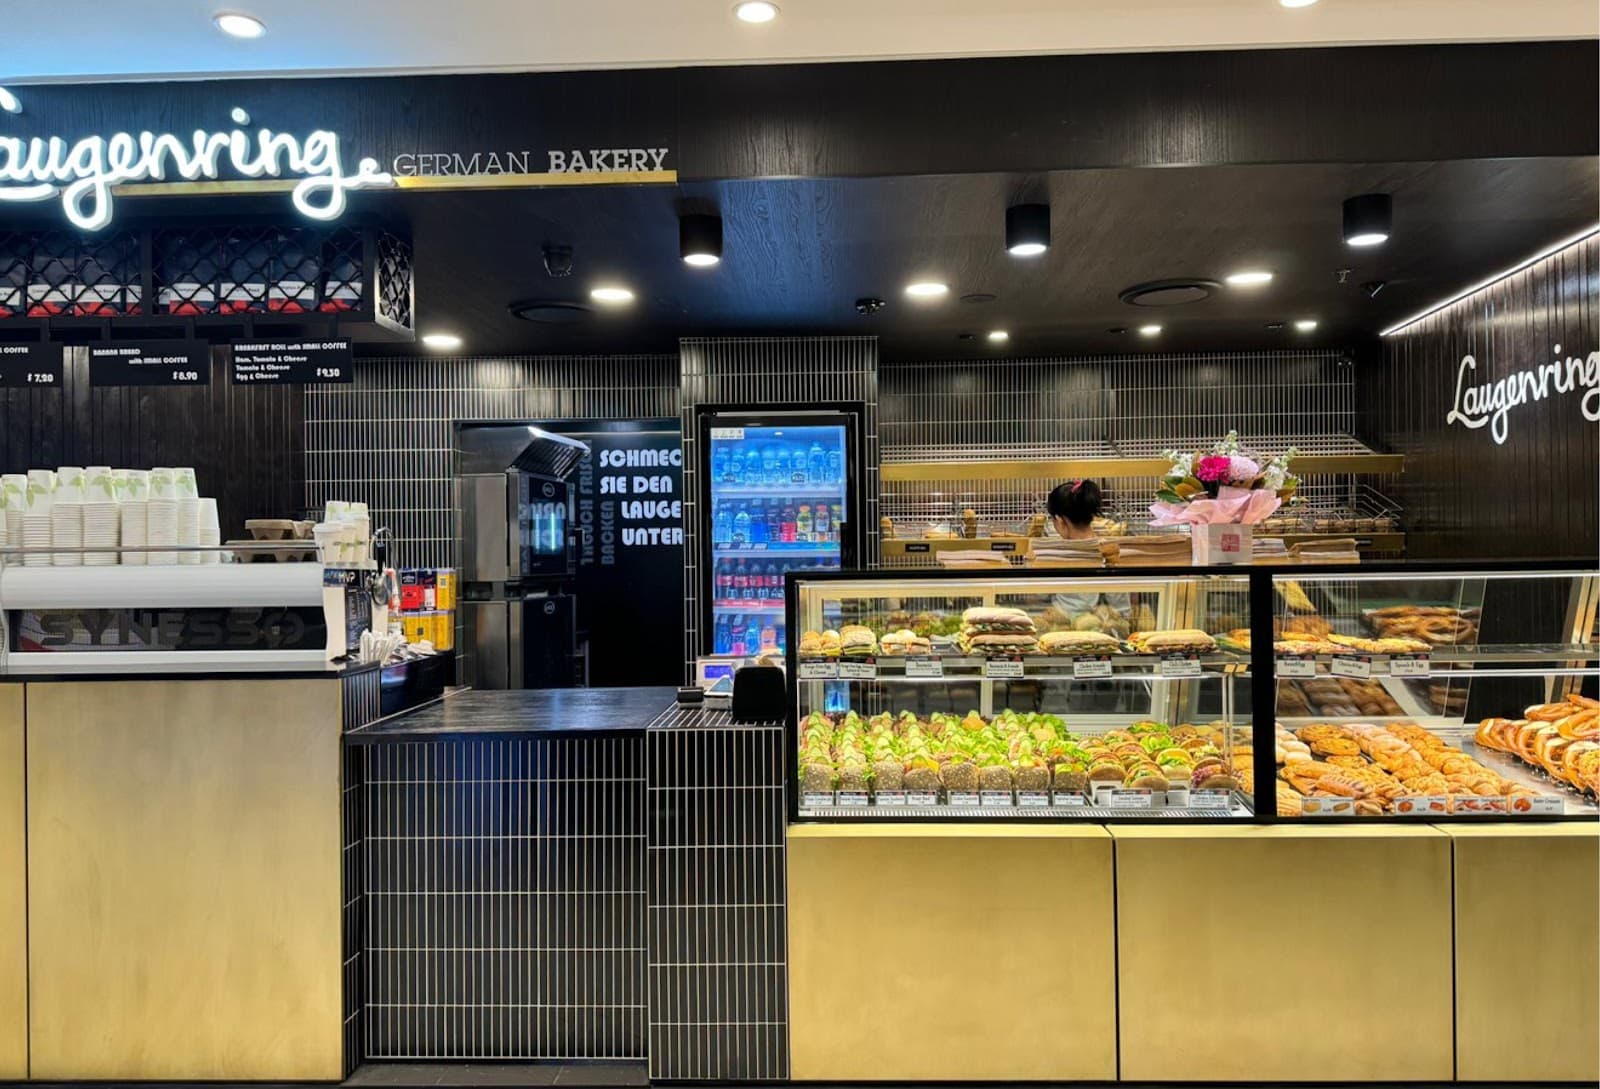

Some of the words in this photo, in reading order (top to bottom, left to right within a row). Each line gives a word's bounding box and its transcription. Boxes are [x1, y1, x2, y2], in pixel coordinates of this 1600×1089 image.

[0, 87, 393, 231] augenring
[393, 151, 530, 176] GERMAN
[548, 148, 668, 173] BAKERY
[600, 449, 682, 468] SCHMEC
[600, 475, 627, 494] SIE
[633, 475, 673, 493] DEN
[621, 500, 682, 519] LAUGE
[601, 501, 615, 565] BACKEN
[622, 527, 683, 546] UNTER
[40, 611, 305, 647] SYNESSO
